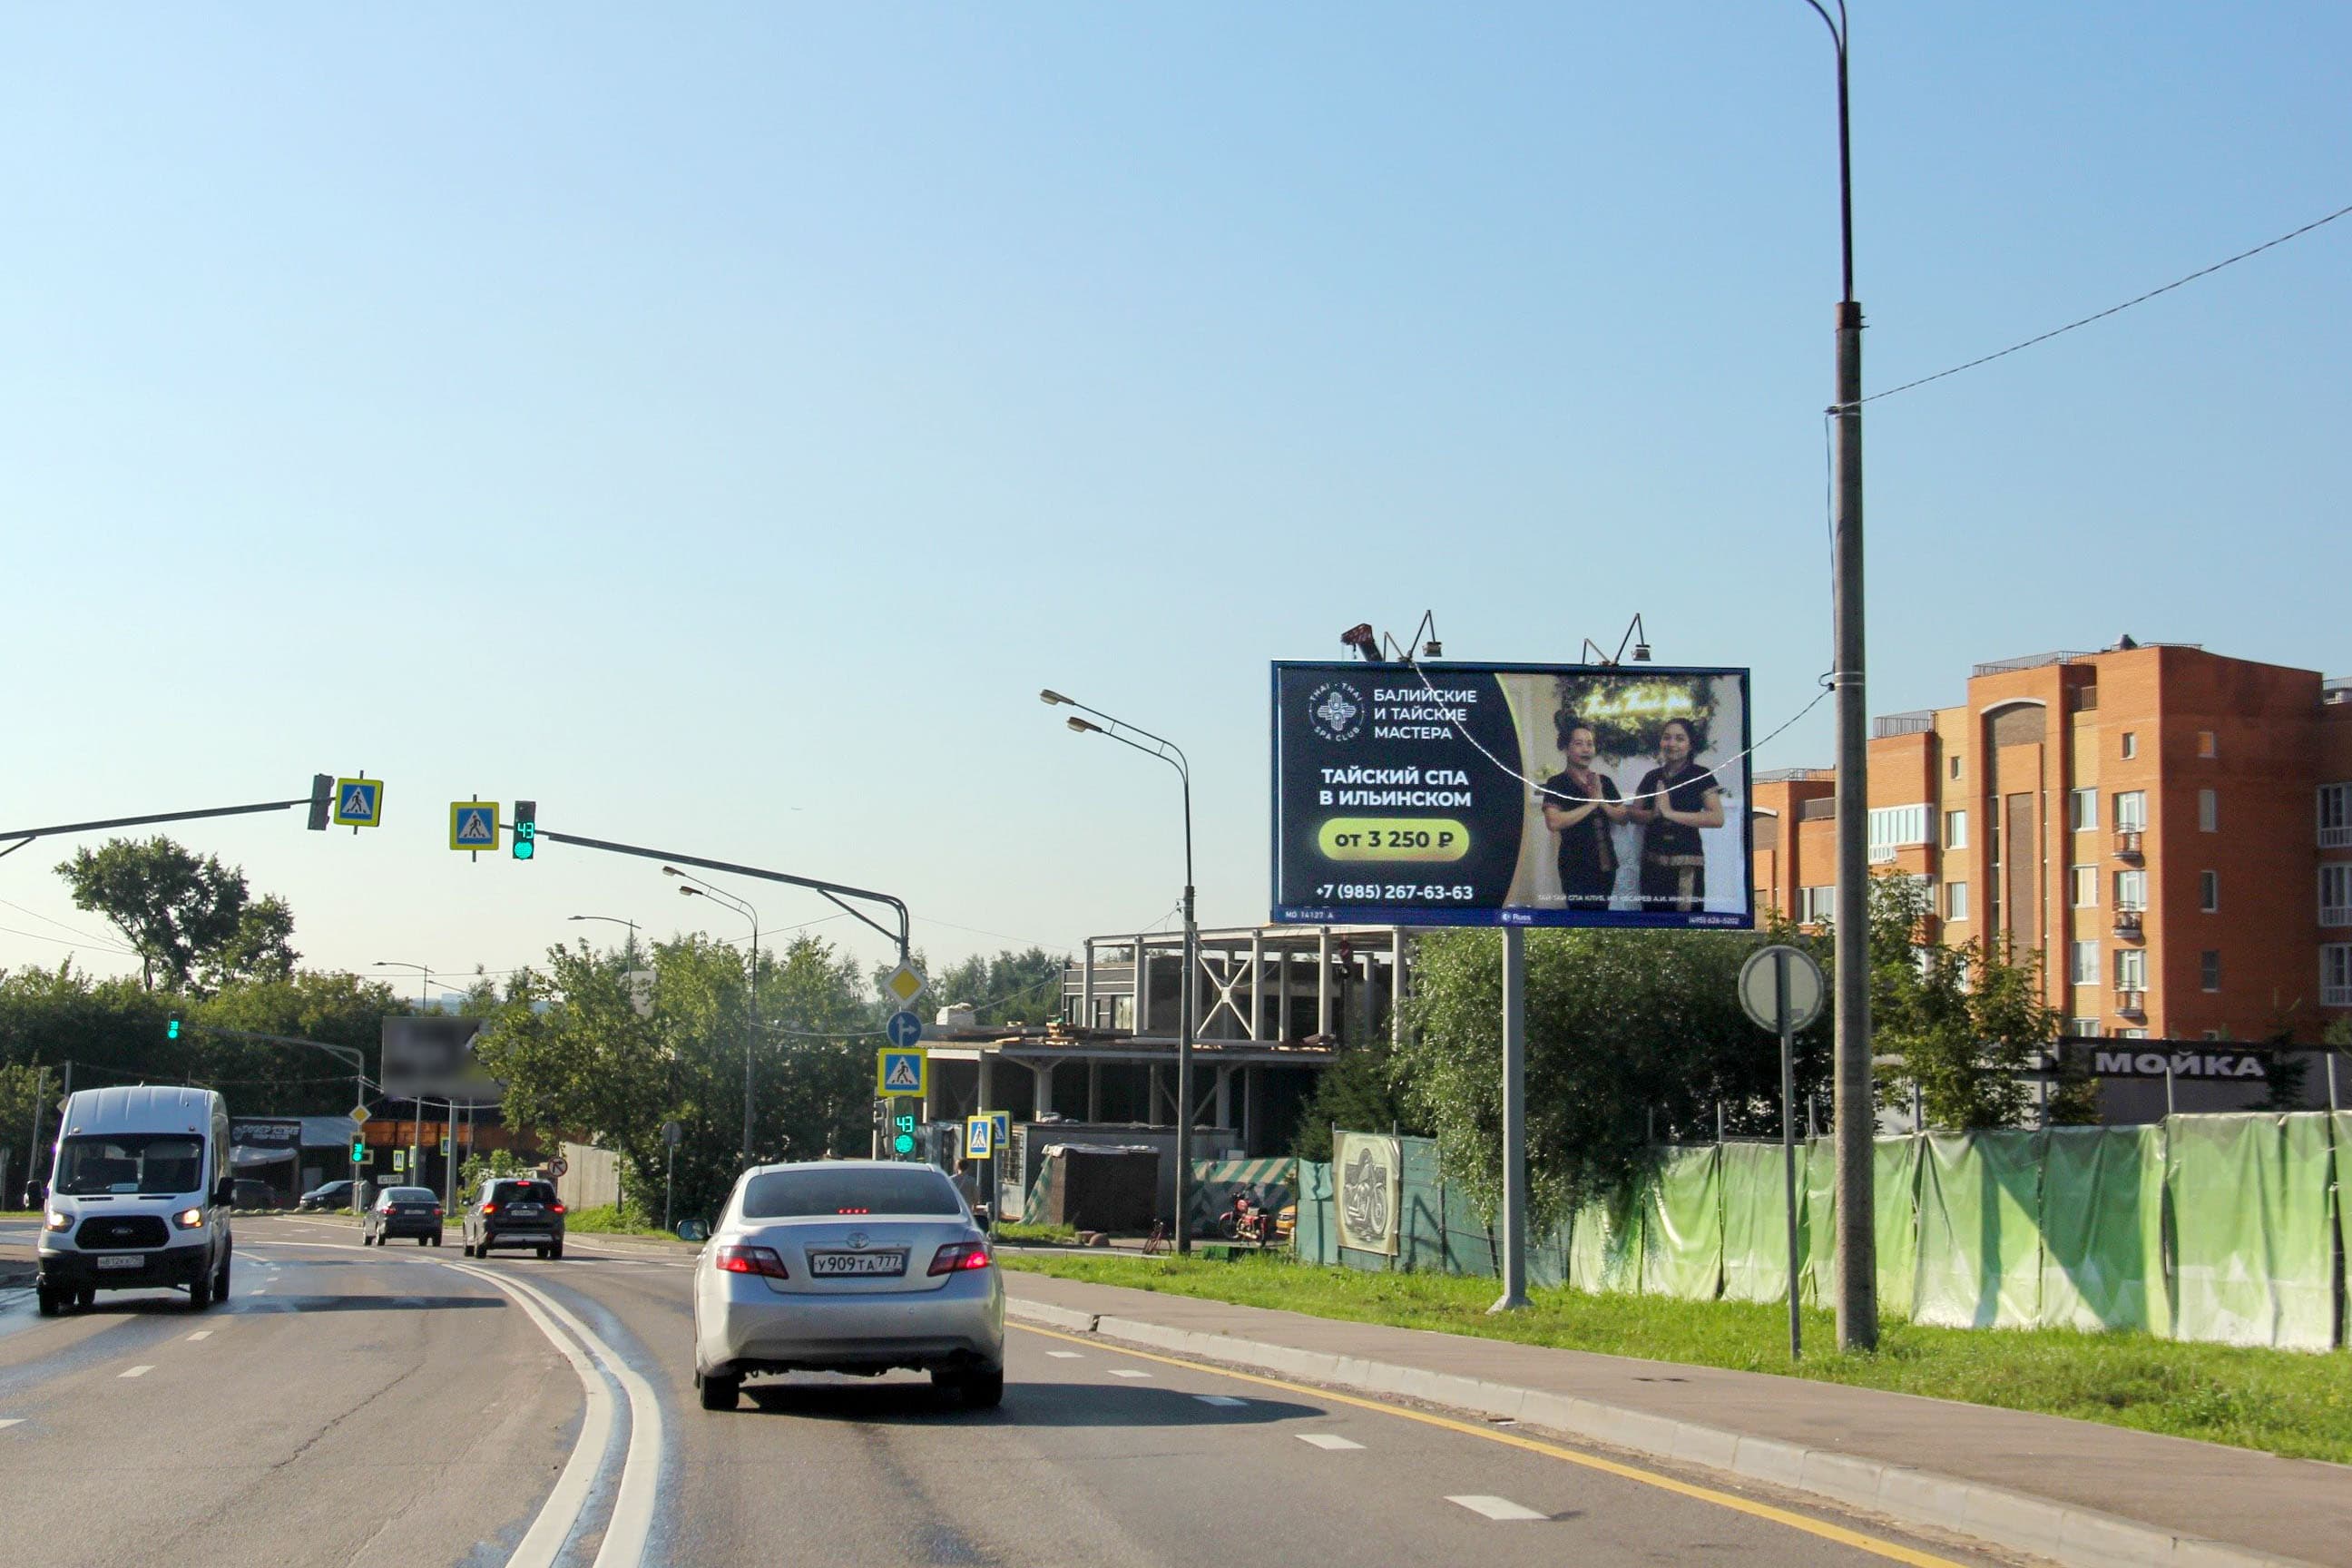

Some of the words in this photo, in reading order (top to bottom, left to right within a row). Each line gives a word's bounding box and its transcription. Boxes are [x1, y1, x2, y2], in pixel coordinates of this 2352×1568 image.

[1309, 683, 1330, 701] THAI
[1342, 682, 1362, 701] THAI
[1374, 688, 1477, 702] БАЛИЙСКИЕ
[1375, 708, 1386, 720] И
[1391, 705, 1467, 721] ТАЙСКИЕ
[1314, 726, 1331, 740] SPA
[1336, 727, 1360, 742] CLUB
[1375, 727, 1453, 740] МАСТЕРА
[1321, 766, 1419, 785] ТАЙСКИЙ
[1425, 770, 1469, 786] СПА
[1319, 791, 1333, 806] В
[1339, 791, 1472, 807] ИЛЬИНСКОМ
[517, 822, 534, 839] 43
[1335, 834, 1360, 848] от
[1368, 831, 1381, 848] 3
[1388, 831, 1430, 848] 250
[1316, 885, 1334, 899] +7
[1338, 885, 1380, 900] (985)
[1385, 886, 1474, 900] 267-63-63
[2095, 1051, 2265, 1076] МОЙКА
[897, 1116, 913, 1132] 43
